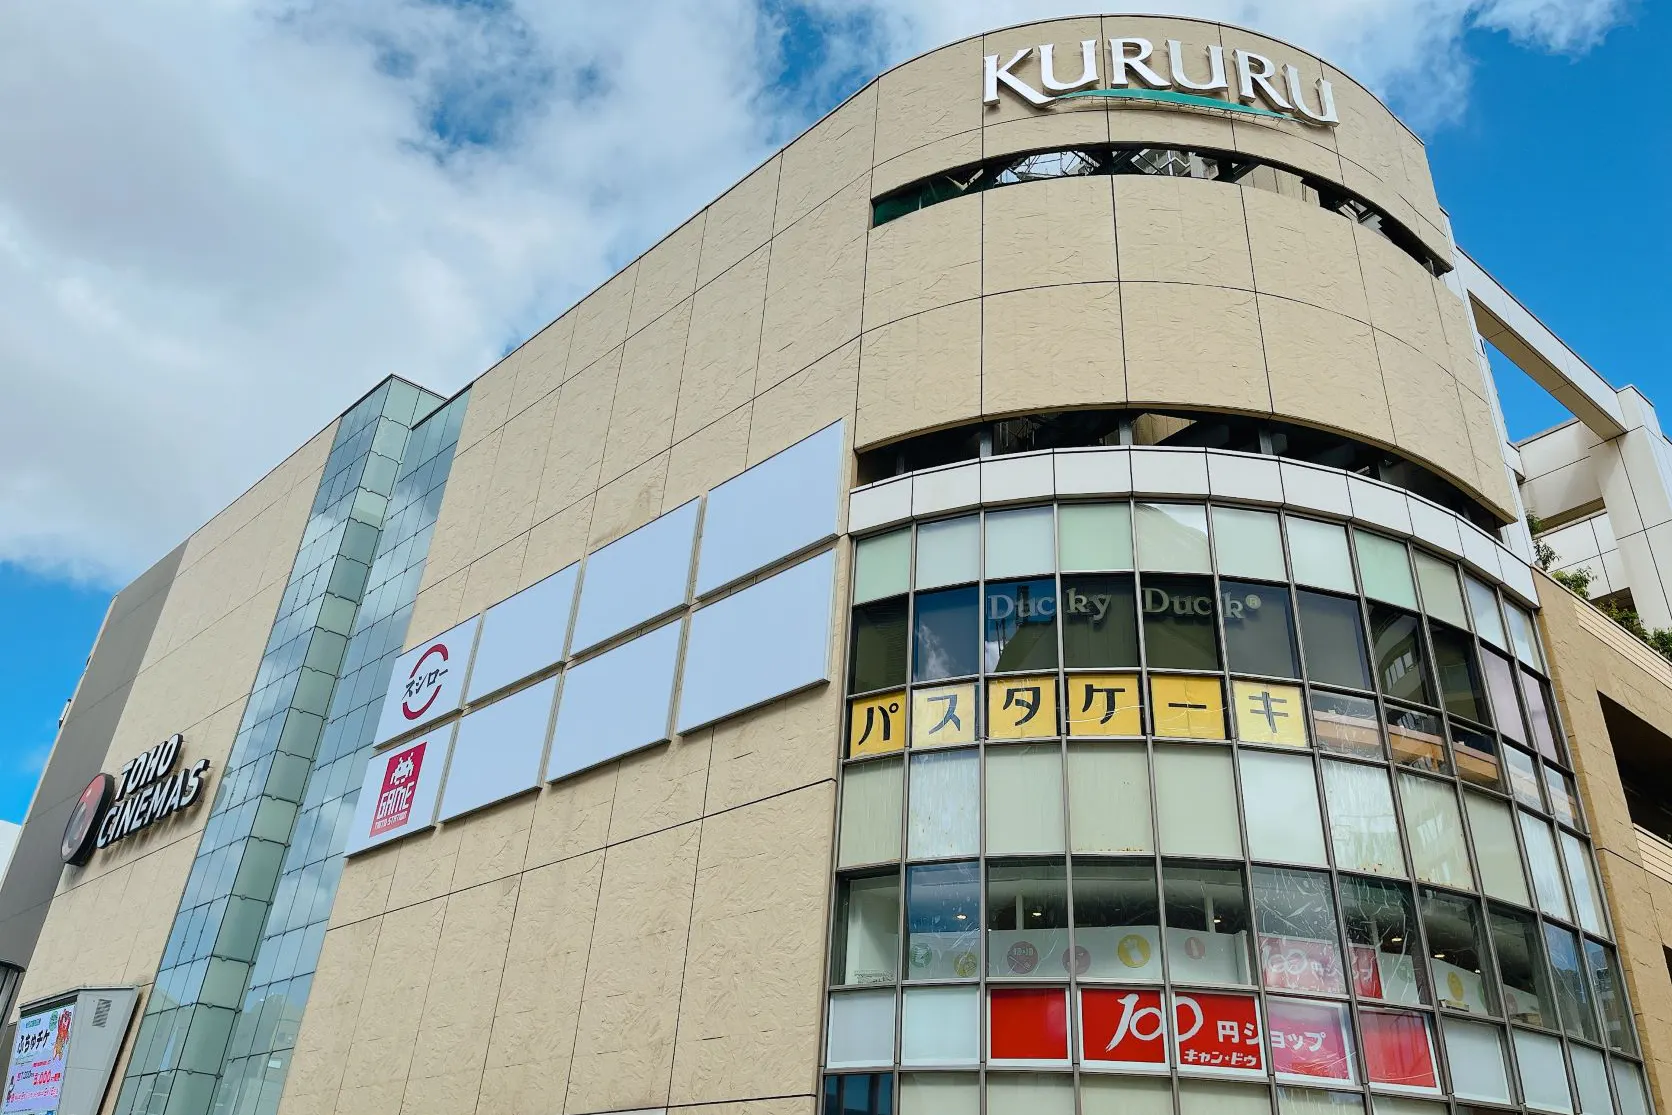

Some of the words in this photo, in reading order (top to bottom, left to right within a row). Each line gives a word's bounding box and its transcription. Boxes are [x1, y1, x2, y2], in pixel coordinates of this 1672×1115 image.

[983, 37, 1340, 127] KURURU
[987, 587, 1111, 621] Ducky
[402, 669, 448, 700] スシロー
[859, 684, 1289, 745] パスタケーキ
[115, 733, 183, 801] TOHO
[97, 759, 210, 848] CINEMAS
